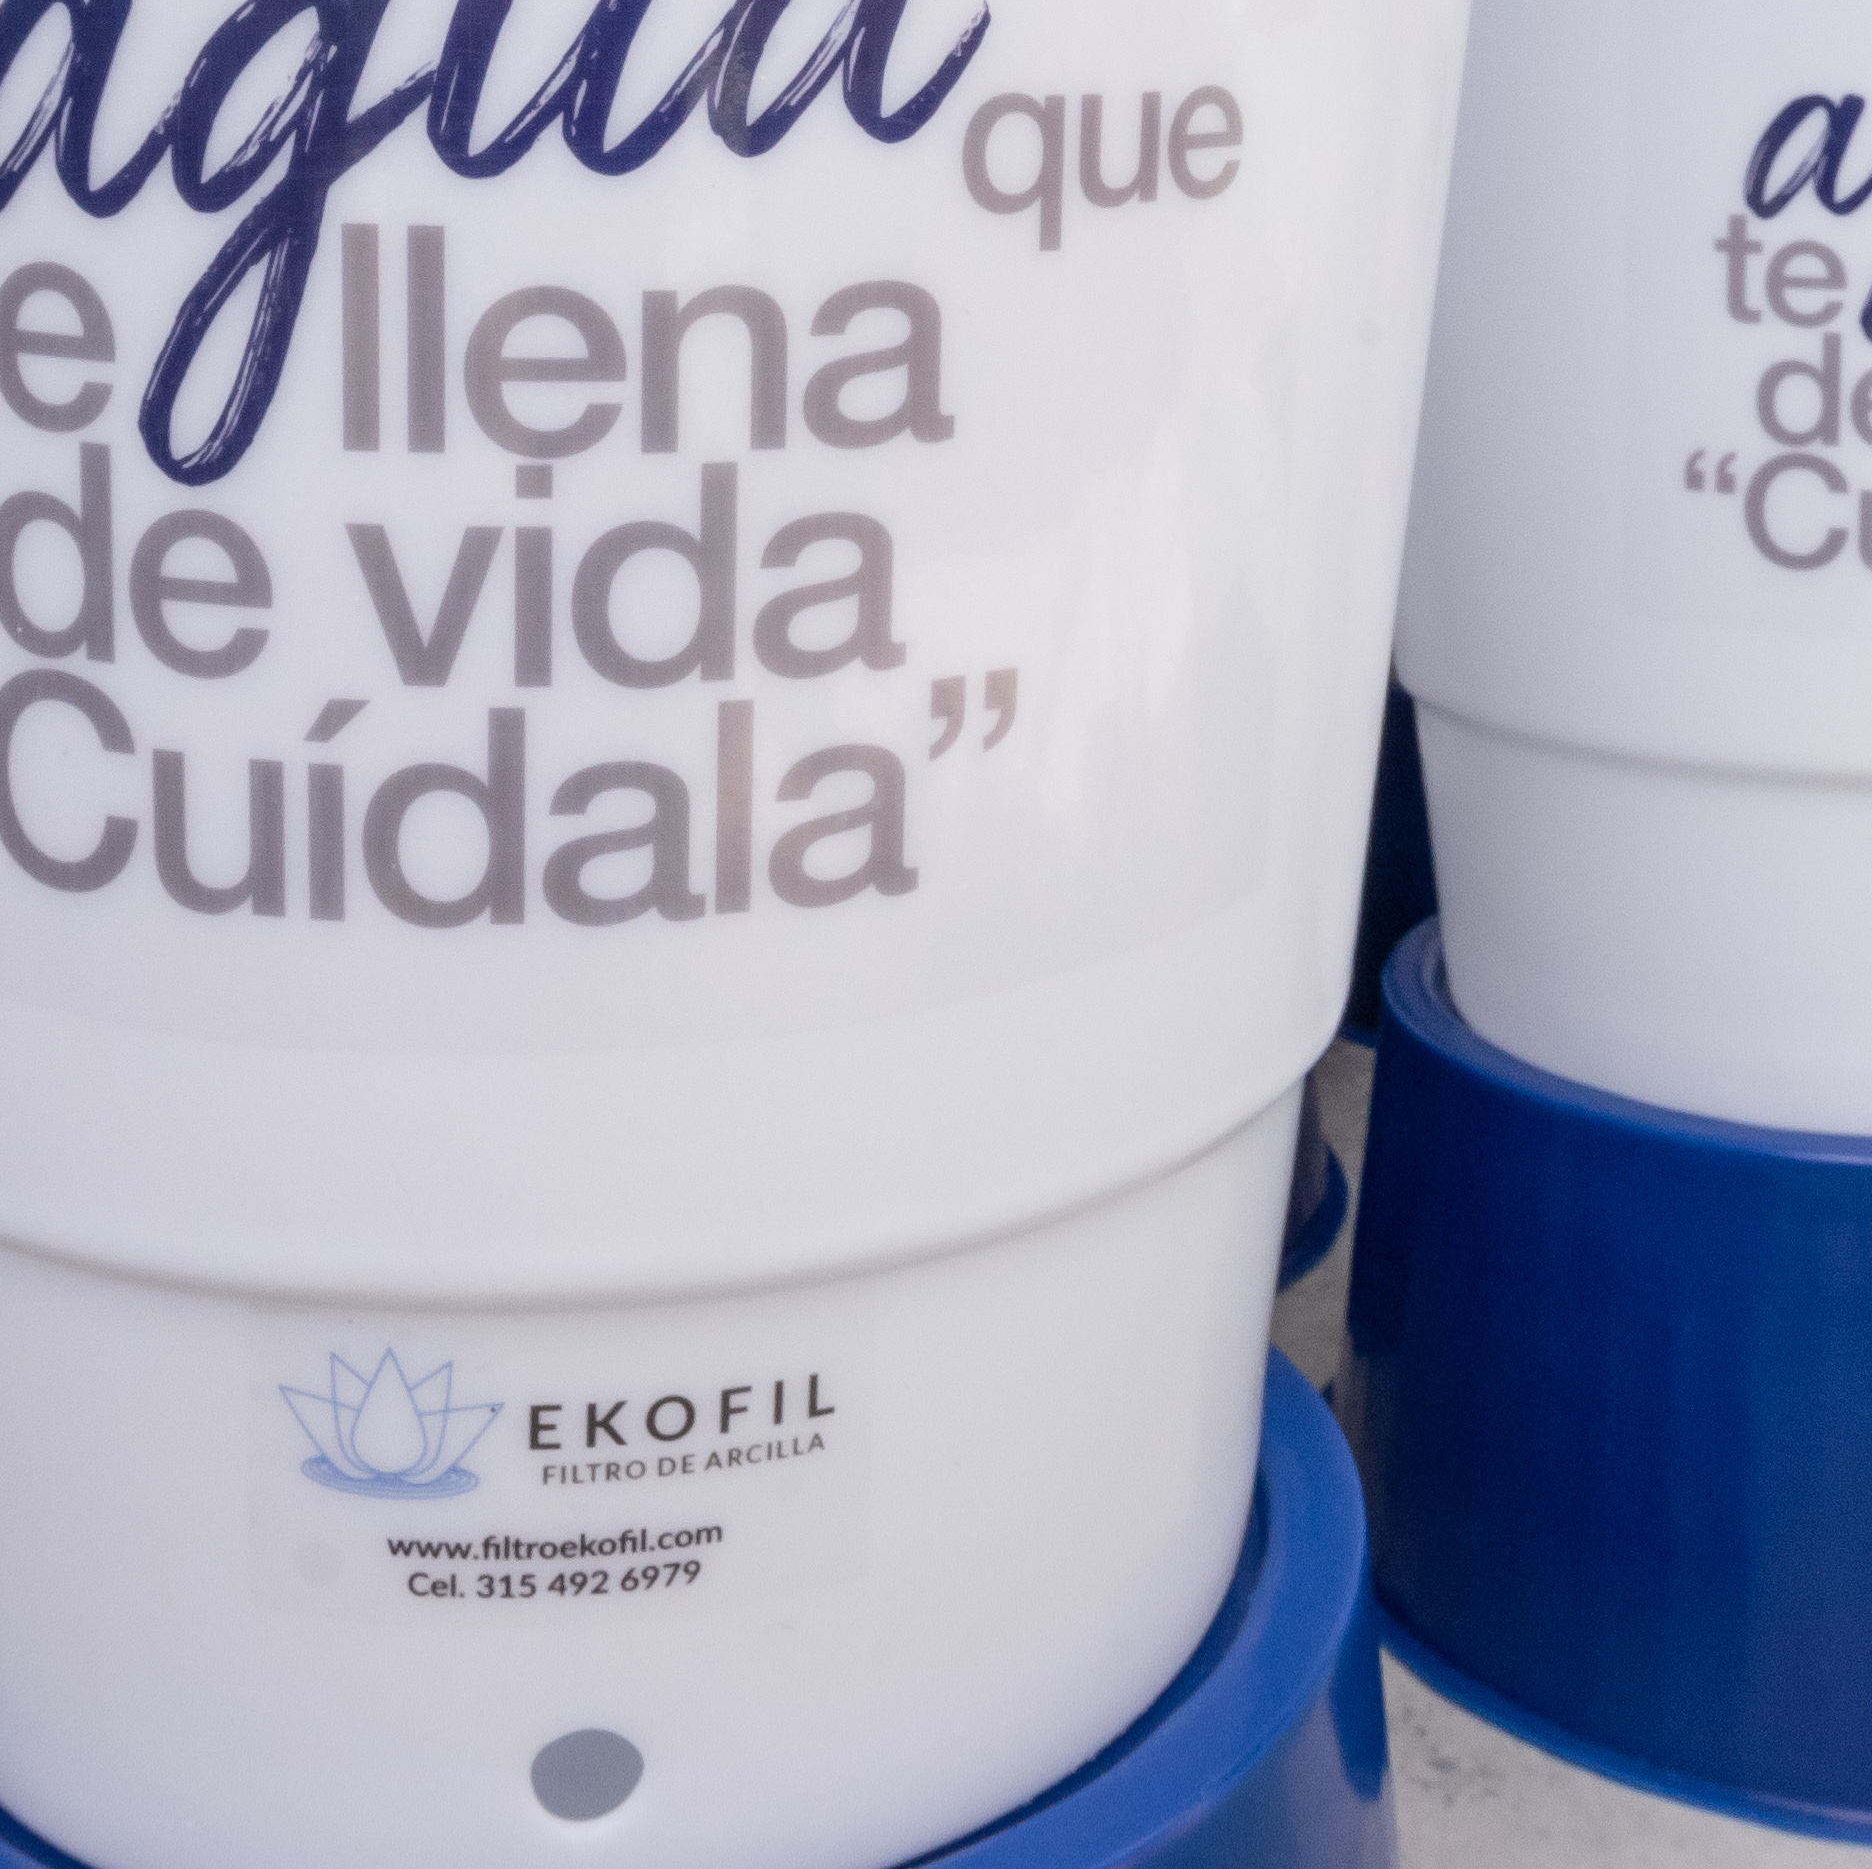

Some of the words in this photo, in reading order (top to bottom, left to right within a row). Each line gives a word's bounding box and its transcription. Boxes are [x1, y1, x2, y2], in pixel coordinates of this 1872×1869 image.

[962, 85, 1243, 251] que
[1714, 215, 1846, 327] te
[341, 223, 954, 454] llena
[346, 462, 905, 689] vida
[529, 1374, 835, 1451] EKOFIL
[542, 1460, 647, 1485] FILTRO
[657, 1454, 694, 1477] DE
[704, 1432, 825, 1471] ARCILLA
[387, 1525, 723, 1560] www.filtroekofil.com
[407, 1571, 464, 1598] Cel.
[477, 1573, 537, 1599] 315
[547, 1569, 609, 1596] 492
[620, 1559, 701, 1592] 6979
